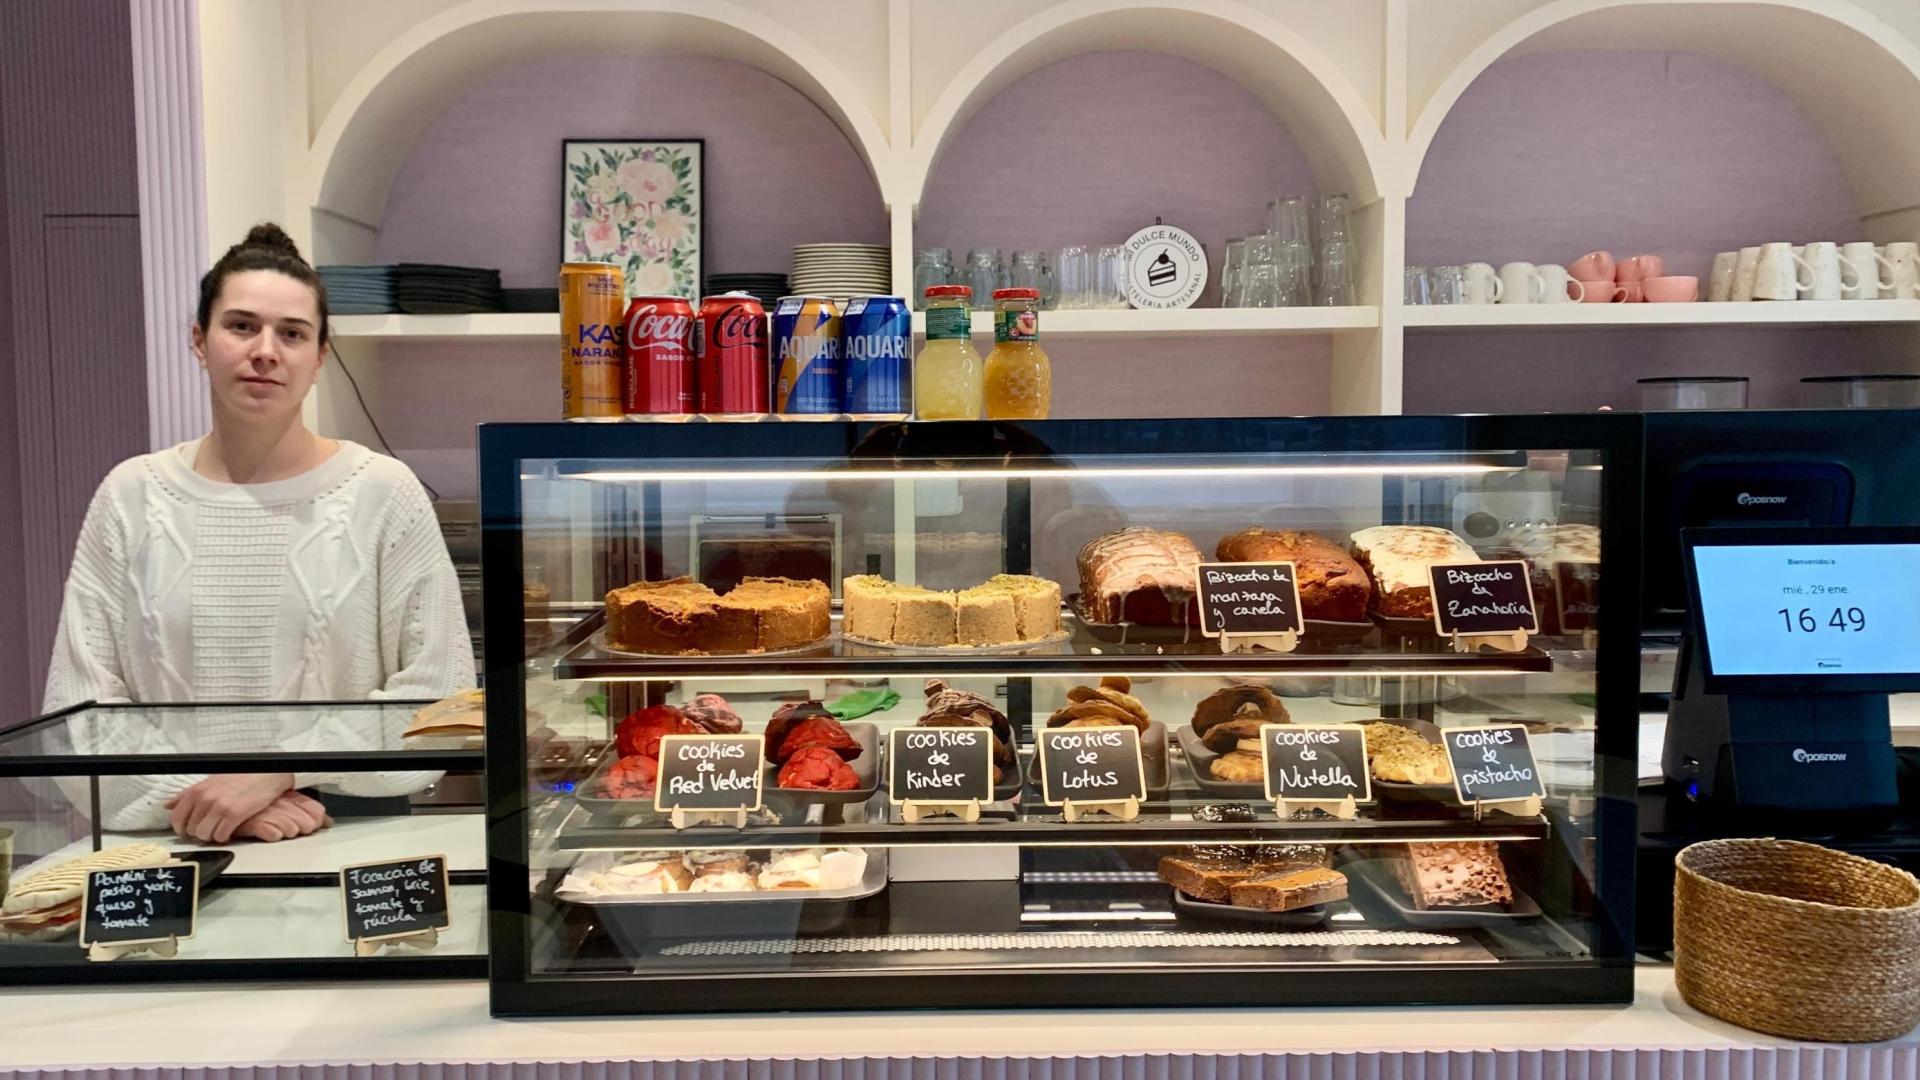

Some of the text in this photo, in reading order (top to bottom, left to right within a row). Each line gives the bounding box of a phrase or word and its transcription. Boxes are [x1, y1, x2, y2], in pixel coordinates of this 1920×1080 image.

[1132, 230, 1165, 250] DULCE
[1168, 232, 1200, 262] MUNDO
[1206, 568, 1291, 586] Bizcocho de
[1446, 568, 1513, 584] Bizcocho
[1471, 582, 1494, 596] de
[1811, 584, 1825, 594] 29
[1213, 600, 1286, 628] y canela
[1448, 600, 1533, 617] Zanahoria
[1778, 607, 1866, 633] 16 49
[927, 750, 950, 766] de
[1076, 749, 1098, 764] de
[1300, 744, 1318, 761] de
[1482, 746, 1501, 765] de
[696, 759, 716, 772] de
[669, 768, 759, 794] Red Velvet
[907, 768, 966, 789] Kinder
[1062, 769, 1119, 789] Lotus
[1280, 765, 1358, 793] Nutella
[1463, 764, 1532, 794] pistacho
[95, 898, 154, 917] queso y
[410, 897, 424, 912] y
[101, 914, 150, 929] tomate
